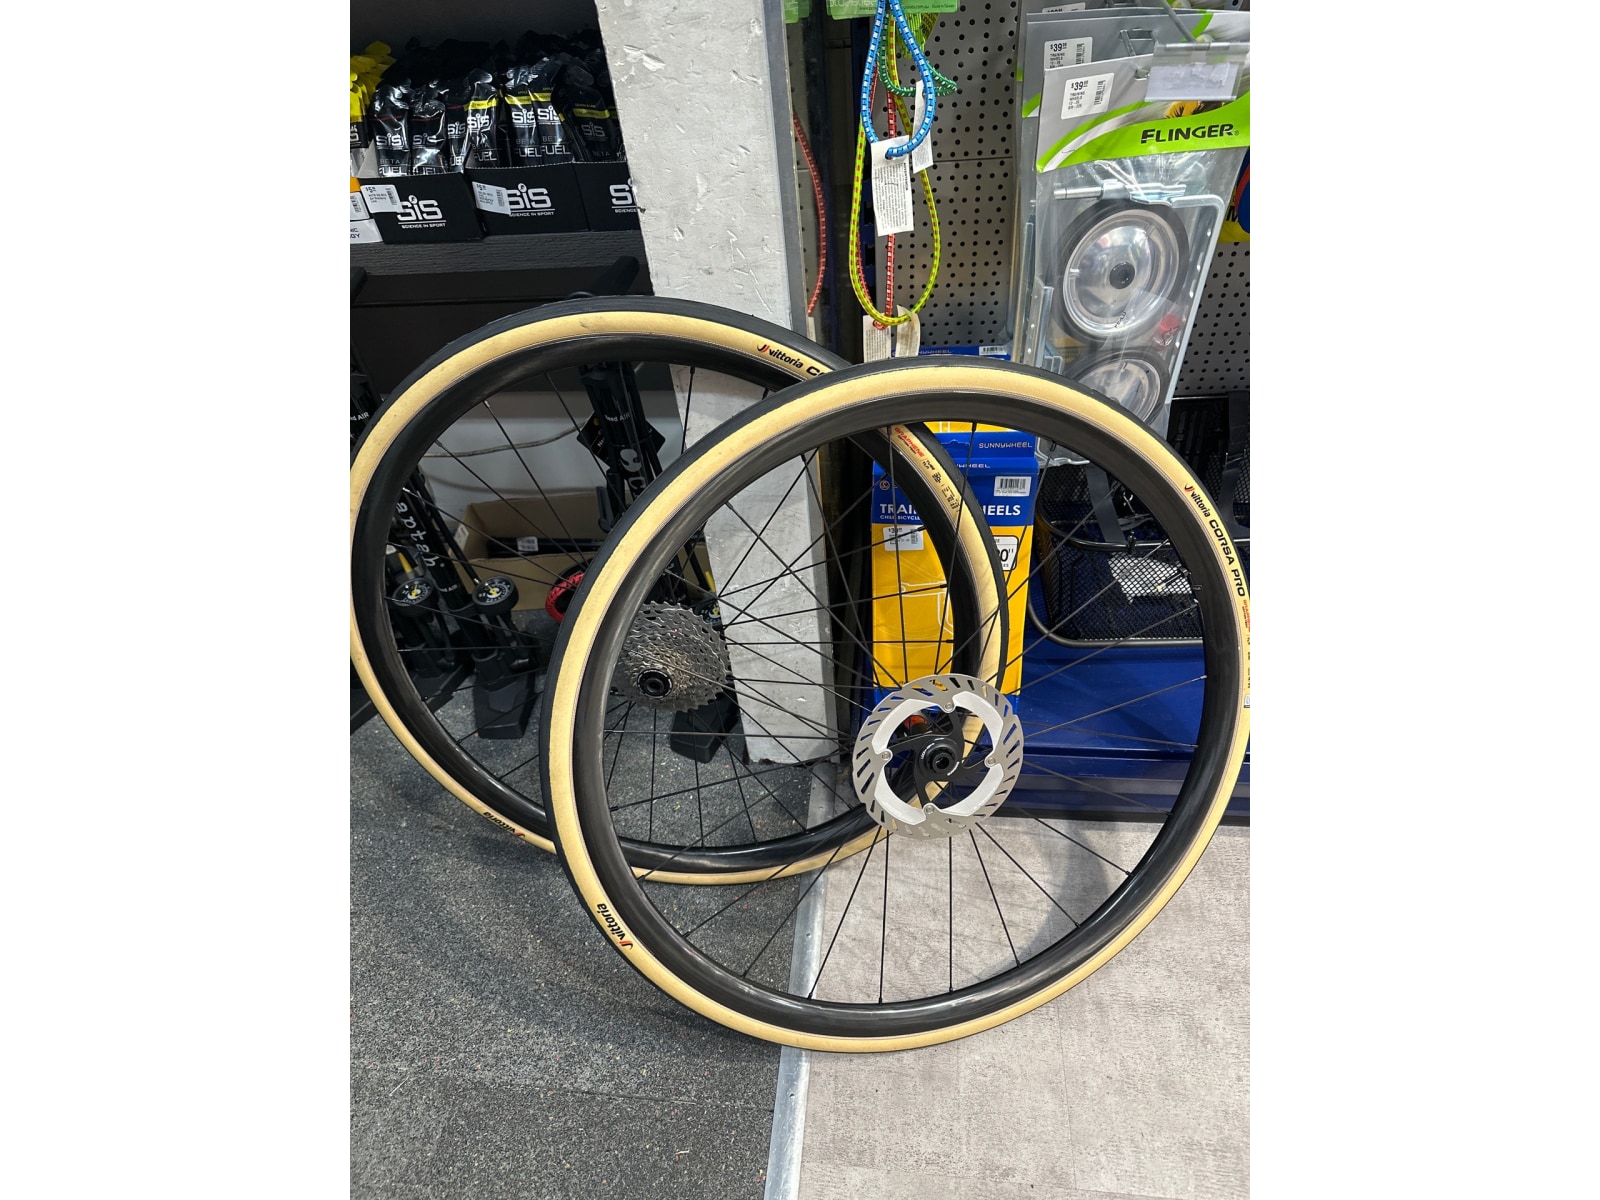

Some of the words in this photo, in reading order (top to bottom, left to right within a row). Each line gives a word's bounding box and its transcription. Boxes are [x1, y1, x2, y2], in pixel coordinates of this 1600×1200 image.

[1140, 123, 1233, 144] FLINGER
[769, 348, 804, 369] vittoria
[894, 427, 924, 457] GRAPHENE
[880, 503, 917, 515] TRAI
[1190, 490, 1211, 518] vittoria
[1209, 518, 1234, 565] CORSA
[1231, 568, 1246, 597] PRO
[483, 811, 516, 833] vittoria
[596, 903, 626, 941] vittoria
